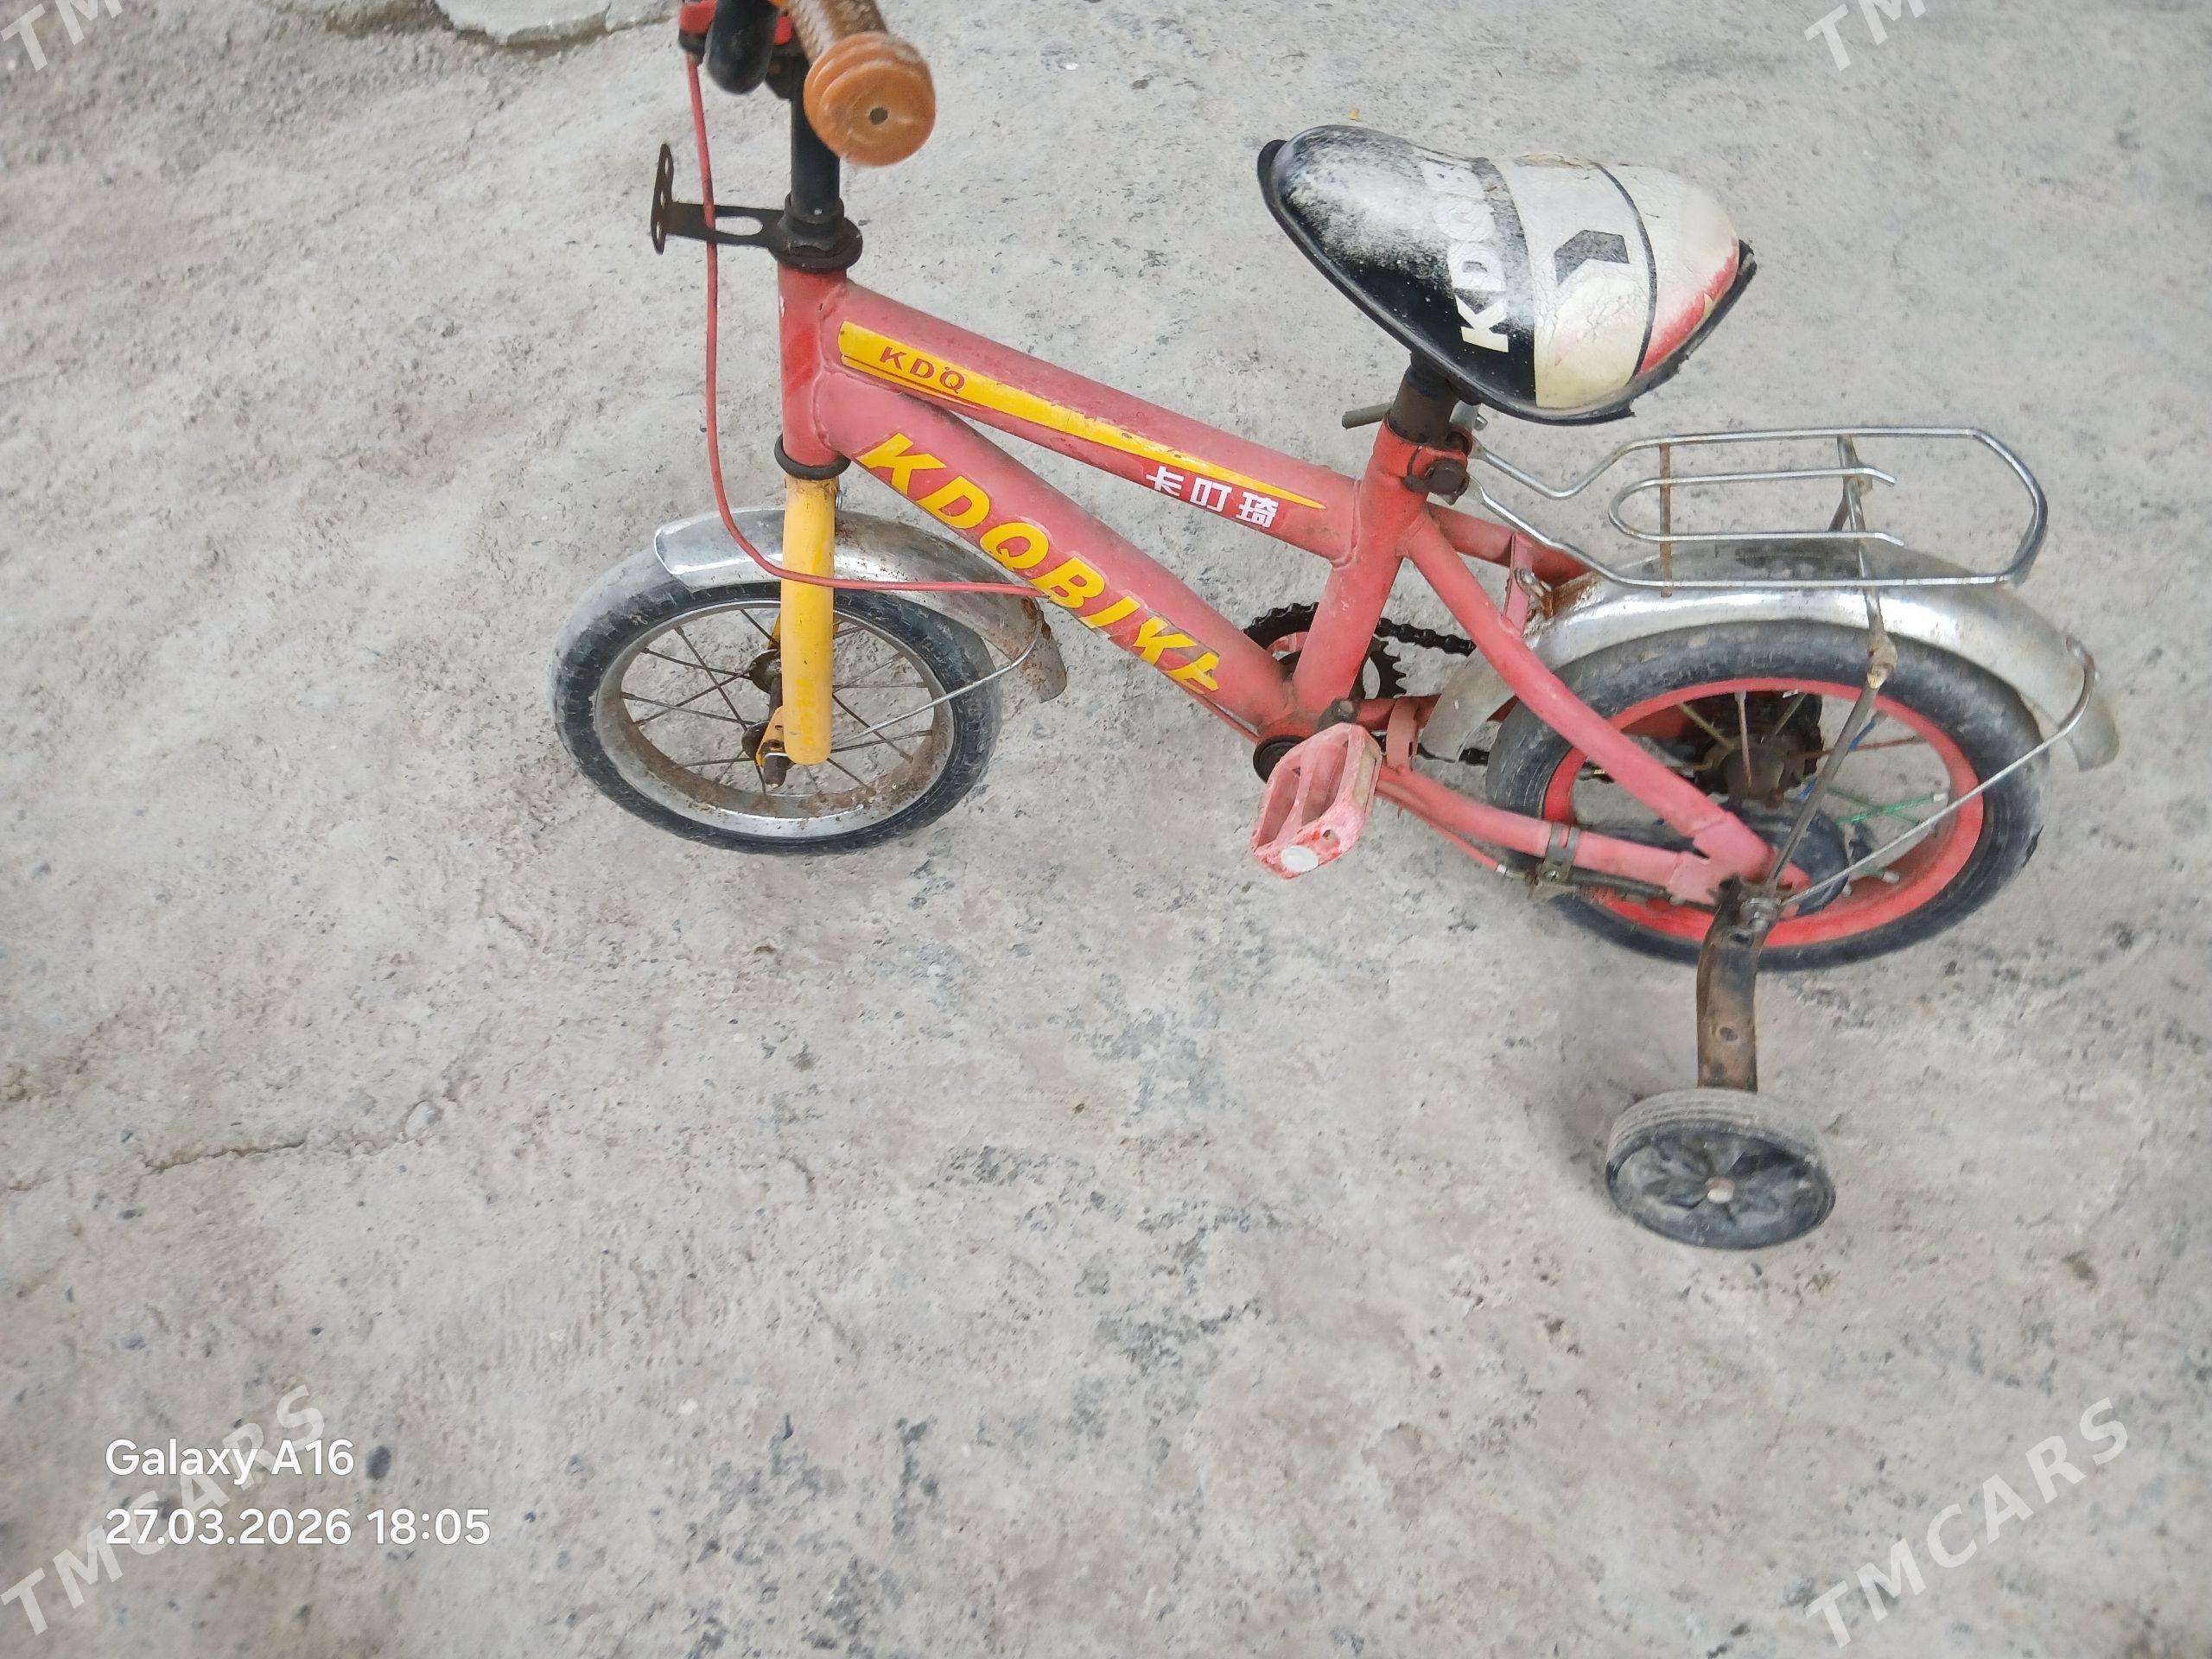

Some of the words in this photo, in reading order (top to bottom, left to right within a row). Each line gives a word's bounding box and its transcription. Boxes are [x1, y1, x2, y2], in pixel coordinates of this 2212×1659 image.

[879, 346, 966, 395] KDQ
[1146, 465, 1279, 528] 卡叮琦
